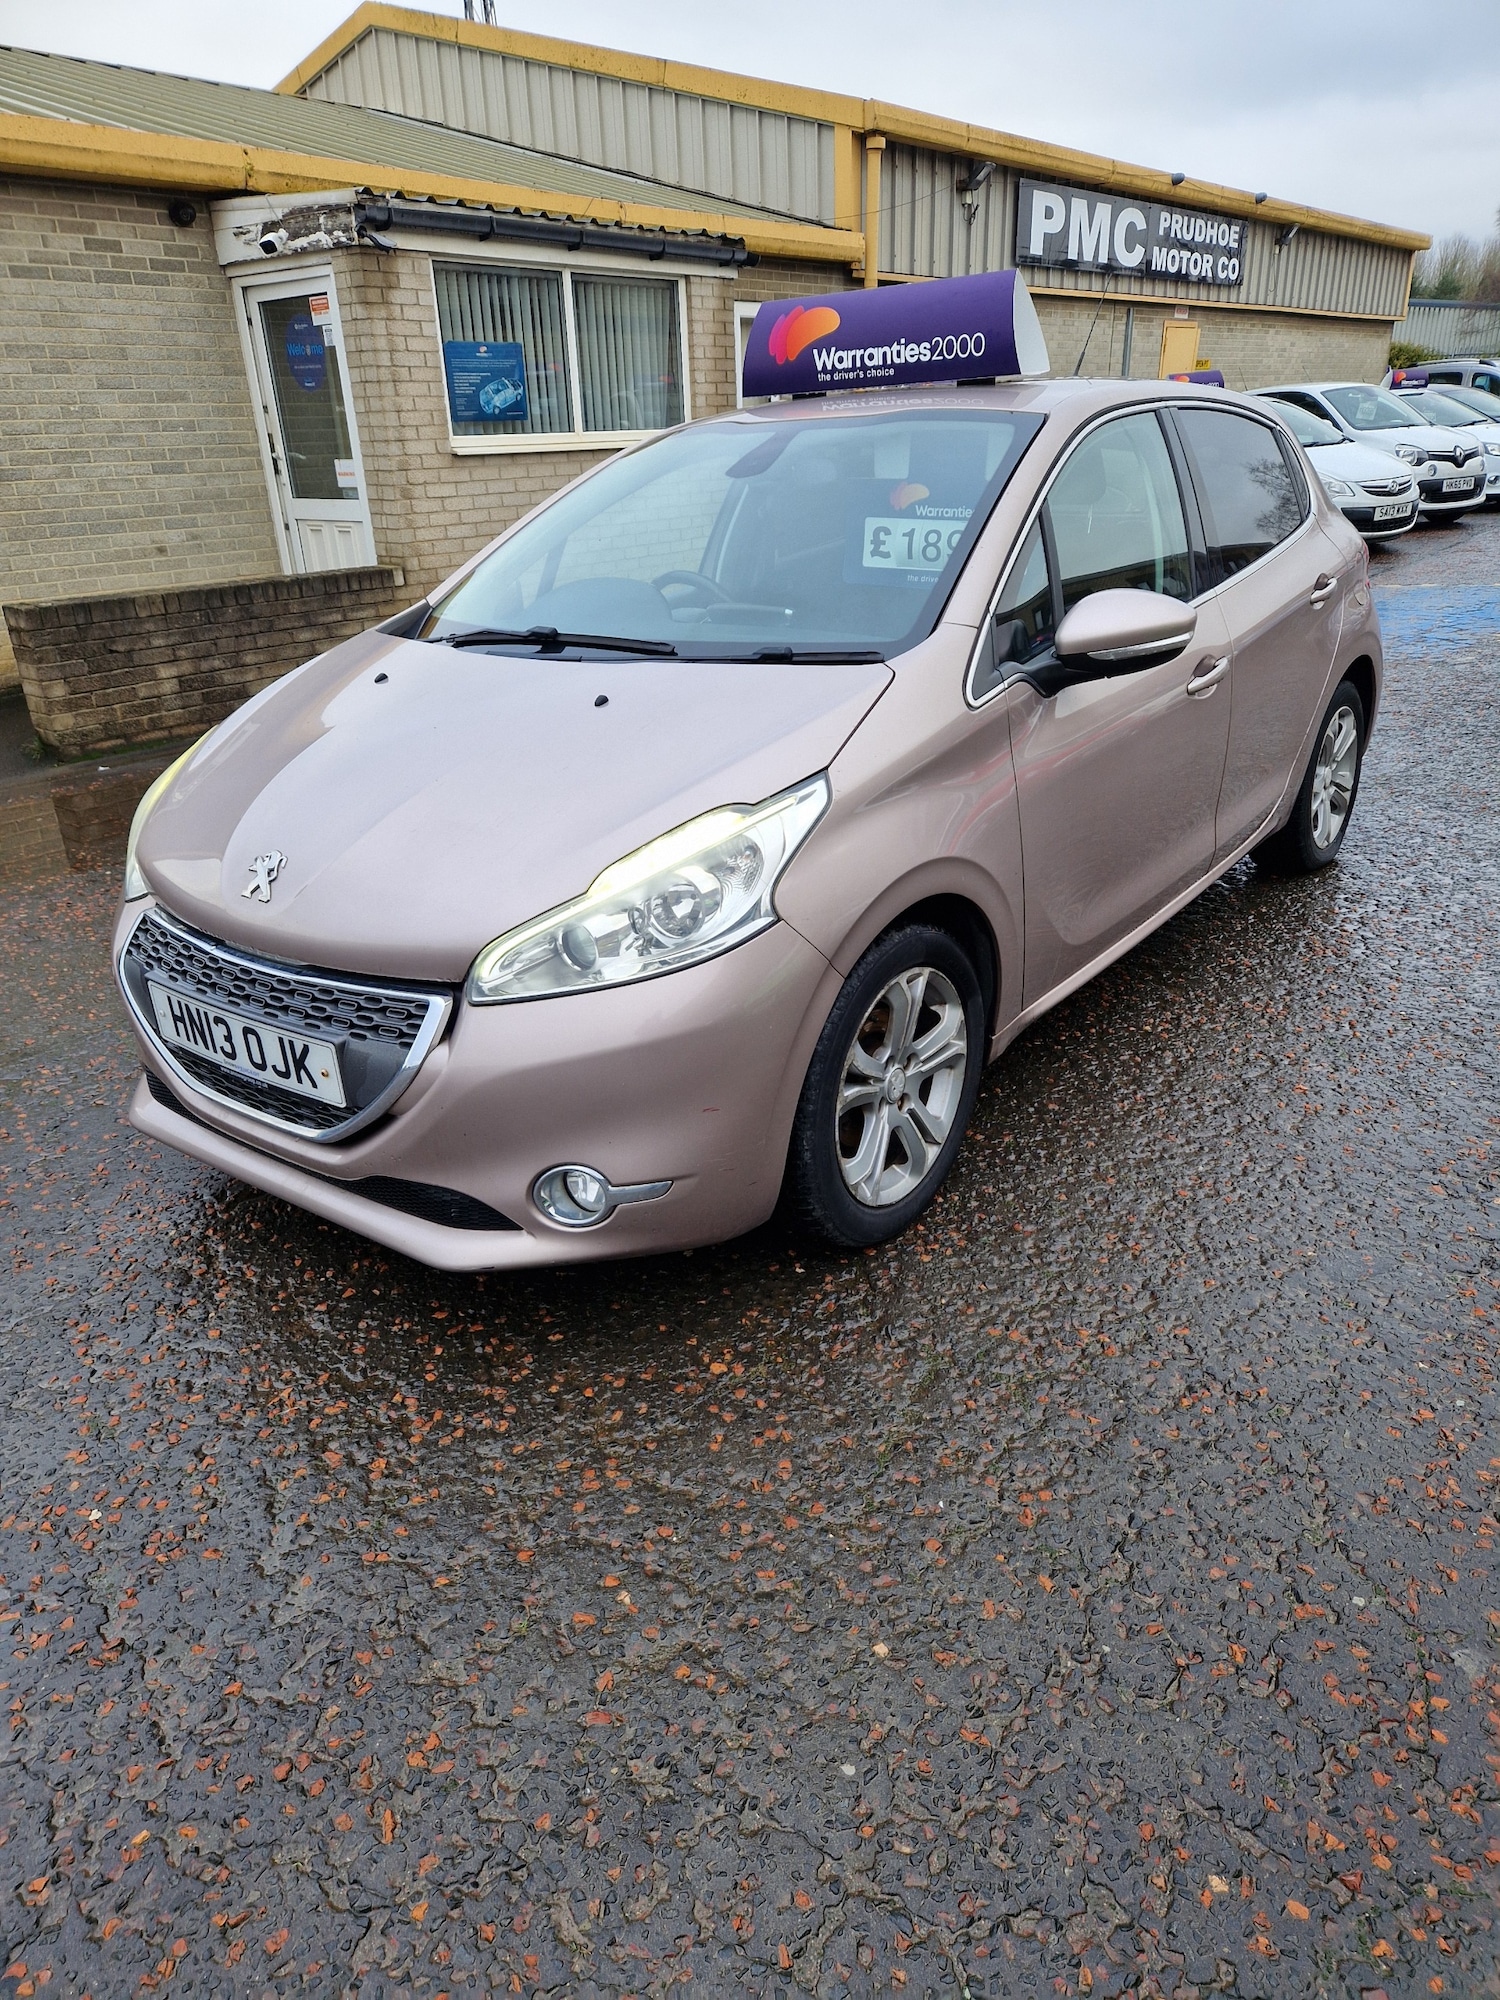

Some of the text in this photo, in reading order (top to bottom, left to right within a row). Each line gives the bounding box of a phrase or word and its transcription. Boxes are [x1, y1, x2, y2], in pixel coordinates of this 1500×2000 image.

[1029, 189, 1147, 267] PMC
[1158, 211, 1240, 249] PRUDHOE
[1151, 246, 1240, 281] MOTOR CO
[813, 332, 986, 371] Warranties2000
[818, 367, 895, 382] the driver's choice
[915, 505, 975, 518] Warrantie
[1379, 506, 1396, 518] SA13
[907, 574, 919, 582] the
[167, 995, 318, 1089] HN13 OJK
